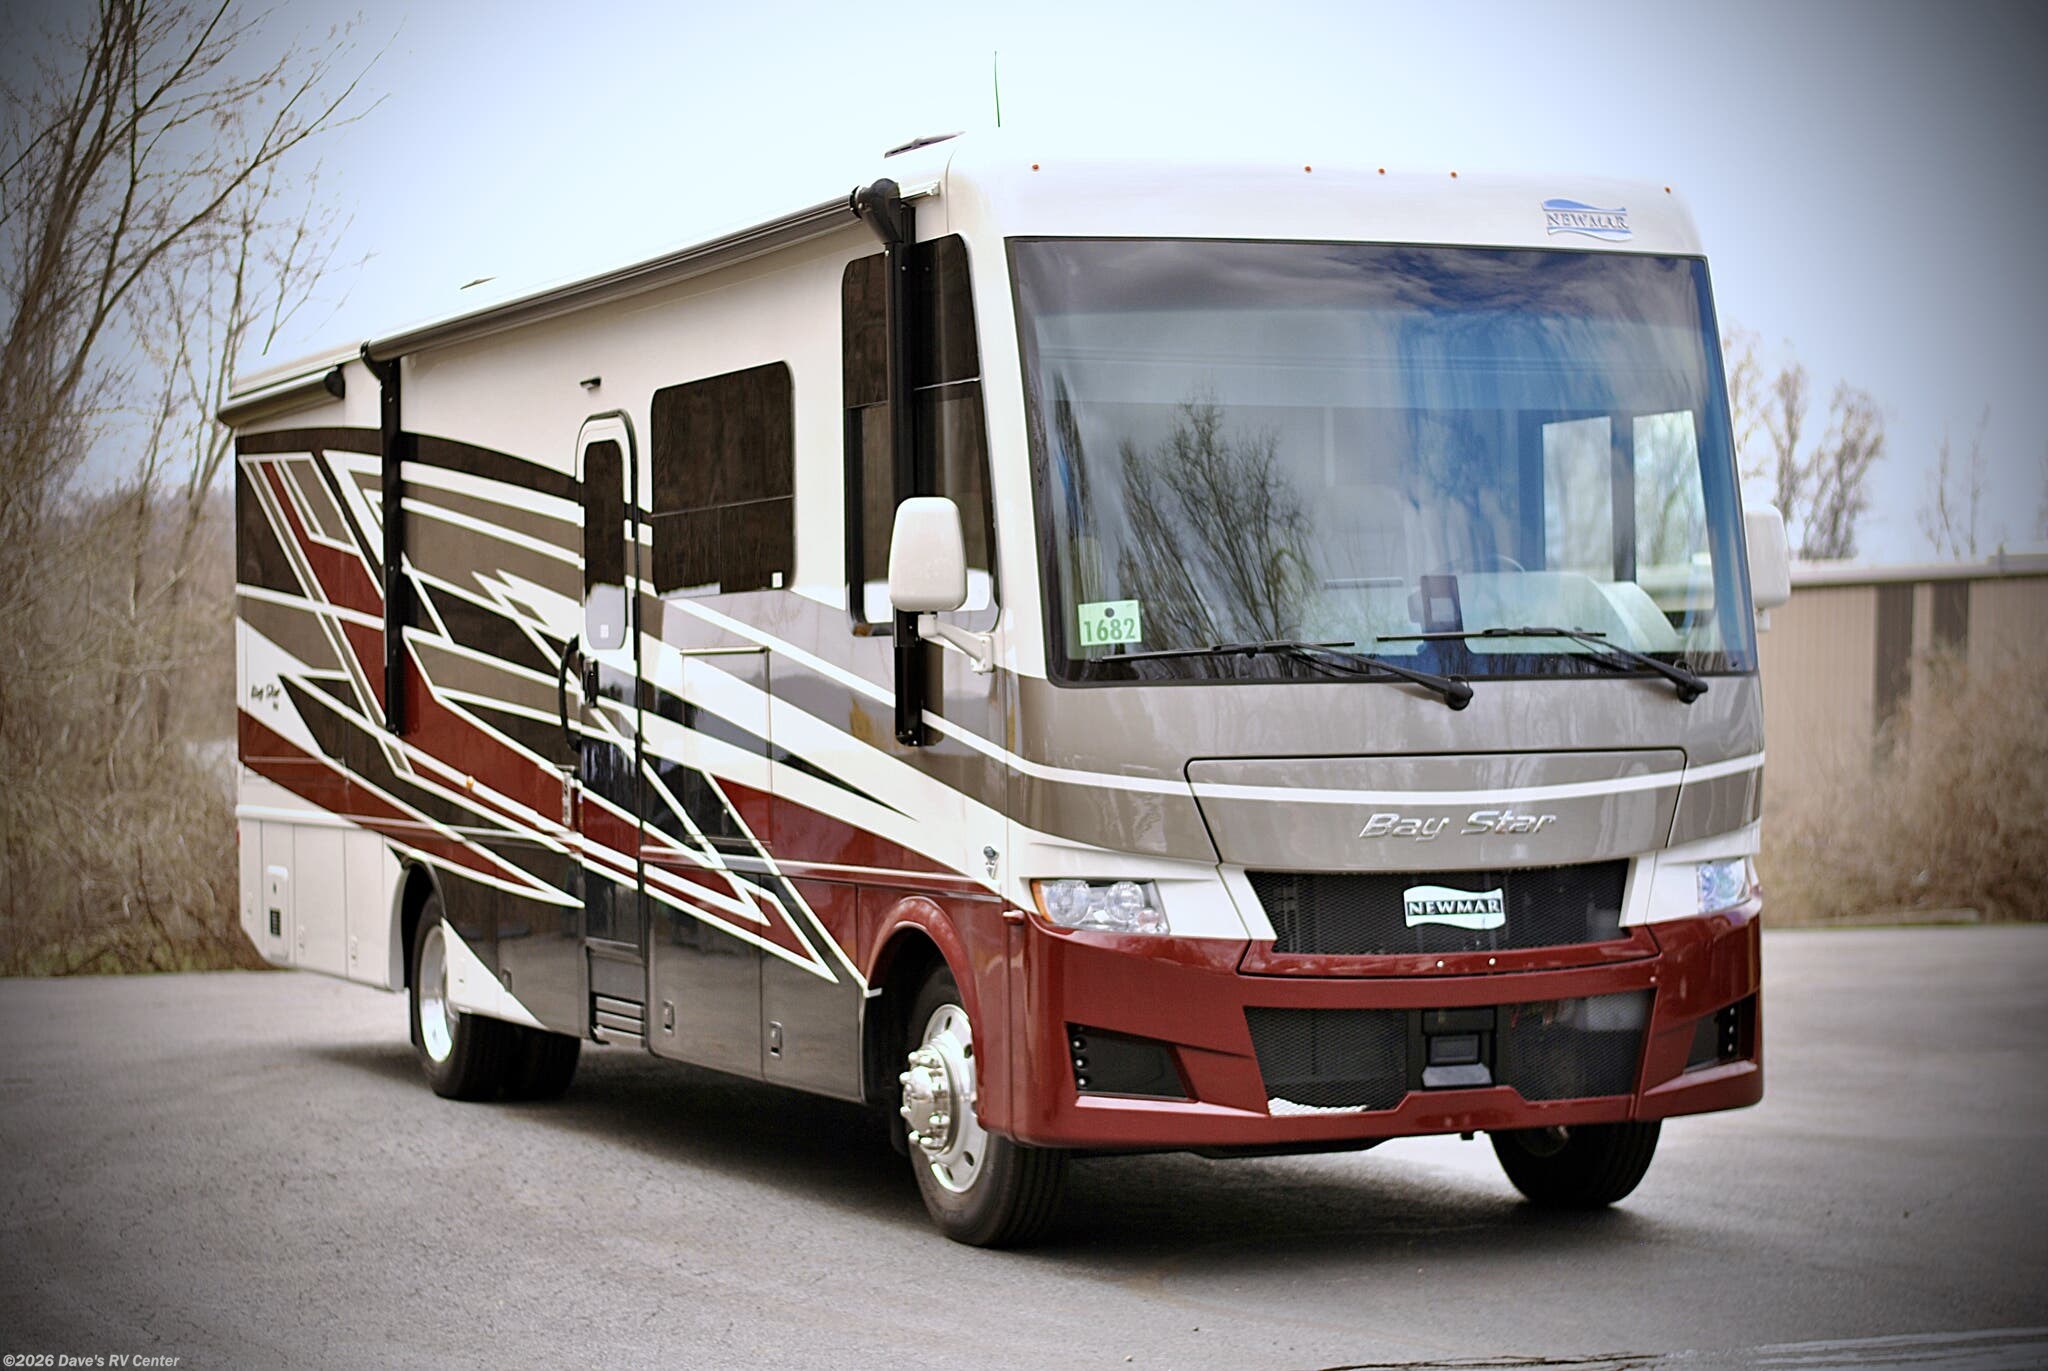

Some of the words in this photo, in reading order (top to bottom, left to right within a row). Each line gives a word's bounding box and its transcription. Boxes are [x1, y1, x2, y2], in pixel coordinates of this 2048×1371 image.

[1083, 618, 1136, 642] 1682
[1359, 813, 1450, 841] Bay
[1461, 810, 1557, 835] Star
[1408, 900, 1500, 915] NEWMAR
